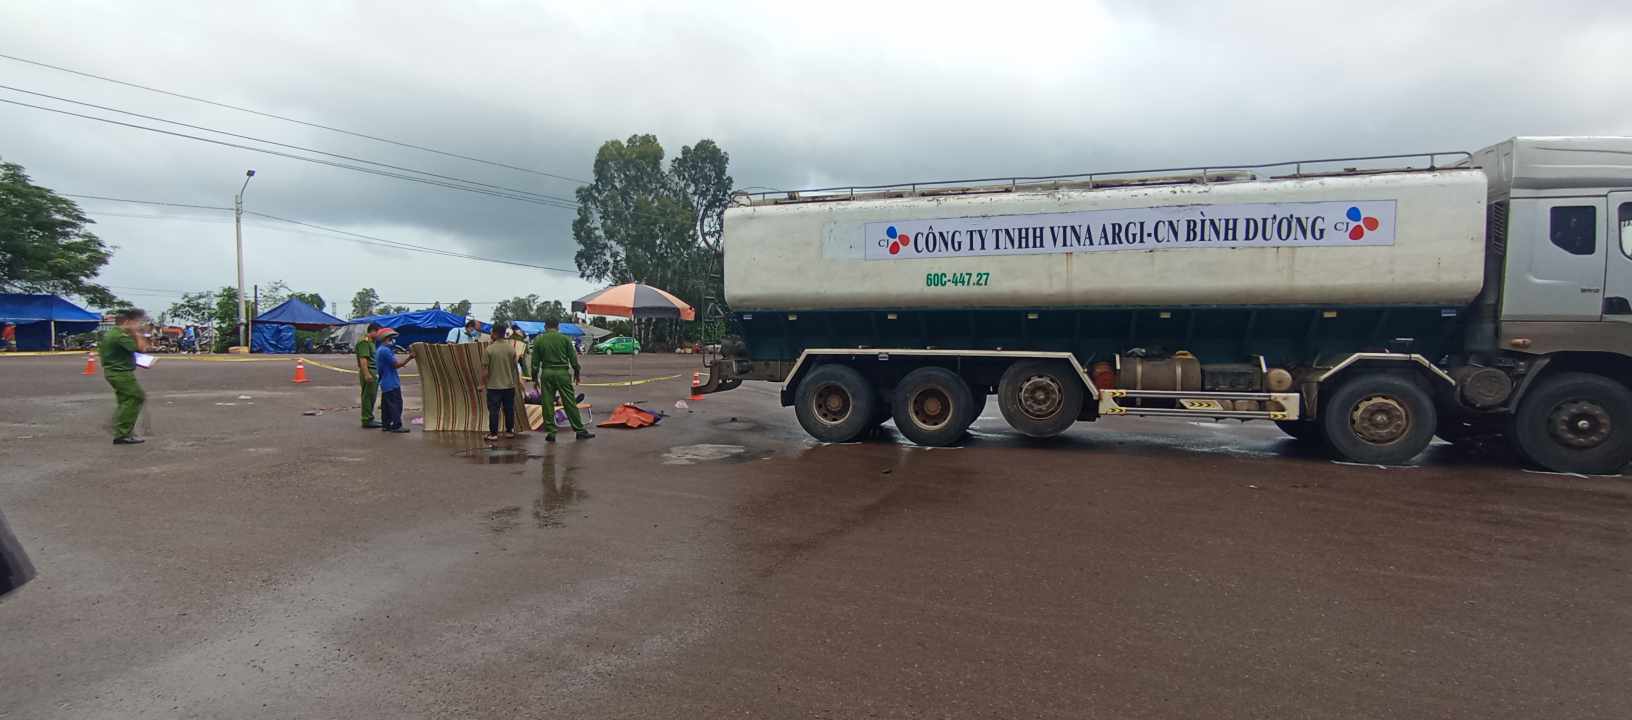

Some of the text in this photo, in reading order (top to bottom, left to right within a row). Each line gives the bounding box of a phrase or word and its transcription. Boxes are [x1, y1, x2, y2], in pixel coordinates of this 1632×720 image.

[913, 211, 1326, 254] CÔNG TY TNHH VINA ARGI-CN BÌNH DƯƠNG
[1334, 221, 1349, 233] CJ
[878, 238, 889, 248] CJ
[926, 272, 990, 287] 60C-447.27
